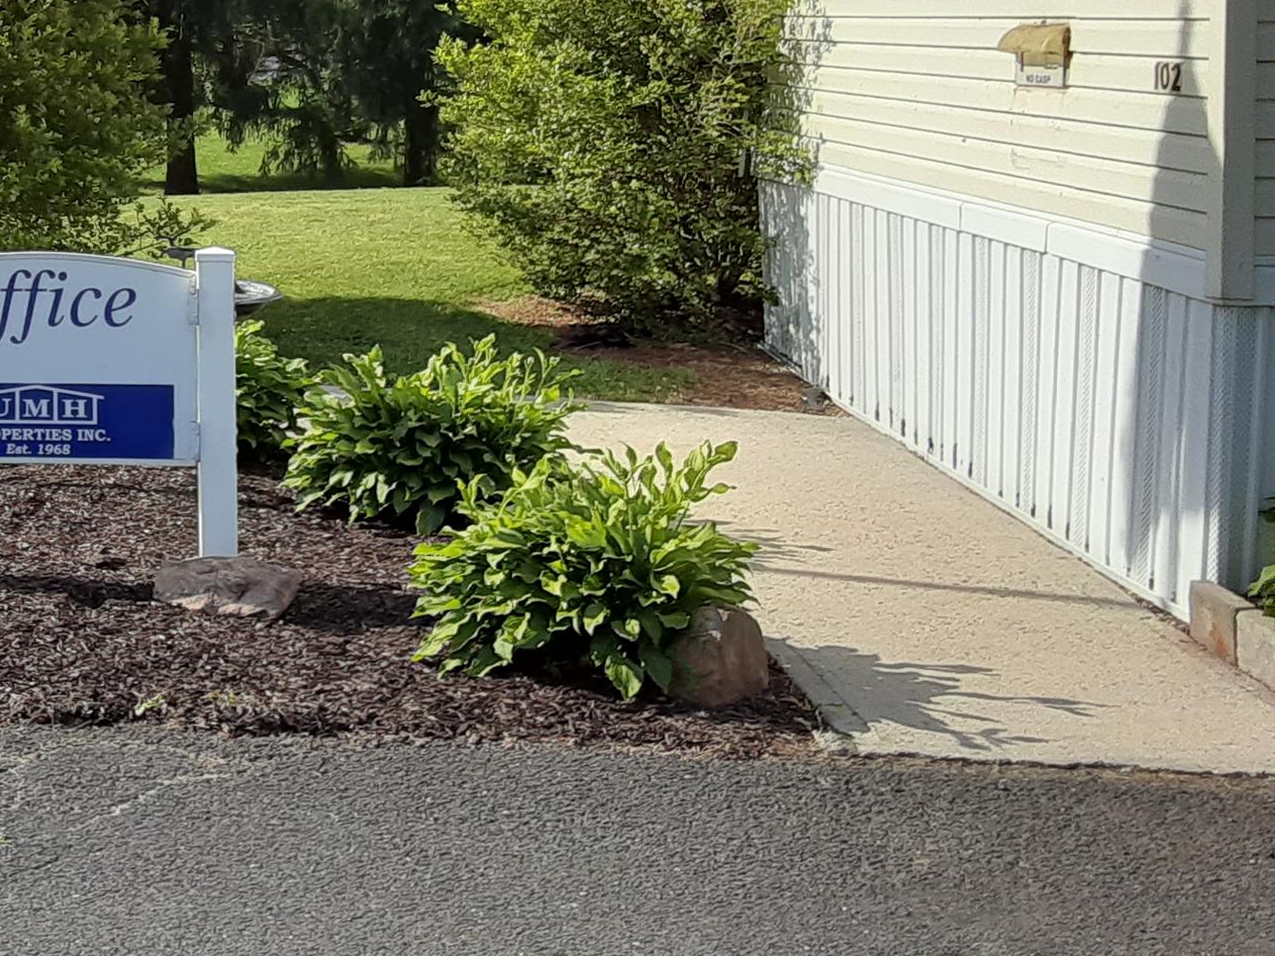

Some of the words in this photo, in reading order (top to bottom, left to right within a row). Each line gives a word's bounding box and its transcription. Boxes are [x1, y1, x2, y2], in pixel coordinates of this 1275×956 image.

[1154, 61, 1182, 91] 102
[77, 429, 111, 442] INC.
[6, 444, 32, 455] Est.
[37, 444, 71, 455] 1968
